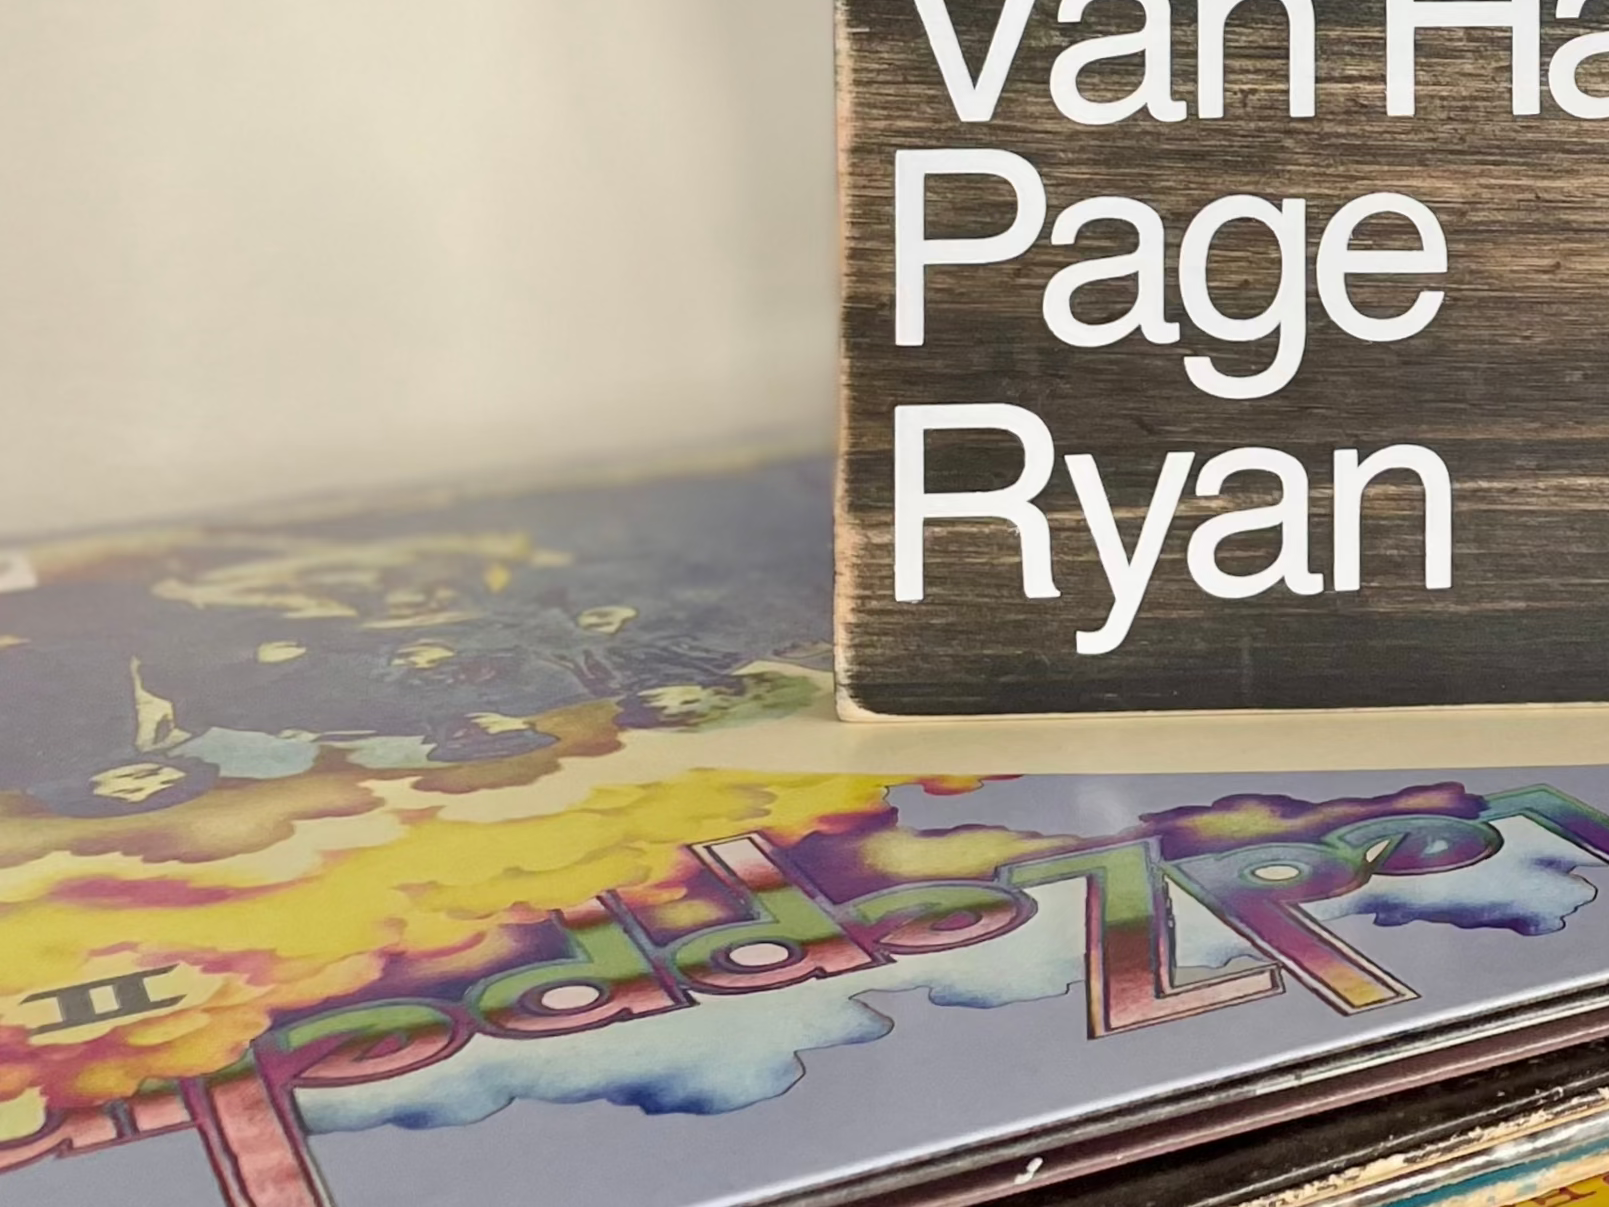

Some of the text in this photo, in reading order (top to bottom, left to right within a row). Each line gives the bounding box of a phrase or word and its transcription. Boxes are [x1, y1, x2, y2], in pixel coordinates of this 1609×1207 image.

[894, 148, 1448, 400] Page
[894, 403, 1452, 655] Ryan
[19, 963, 188, 1036] II
